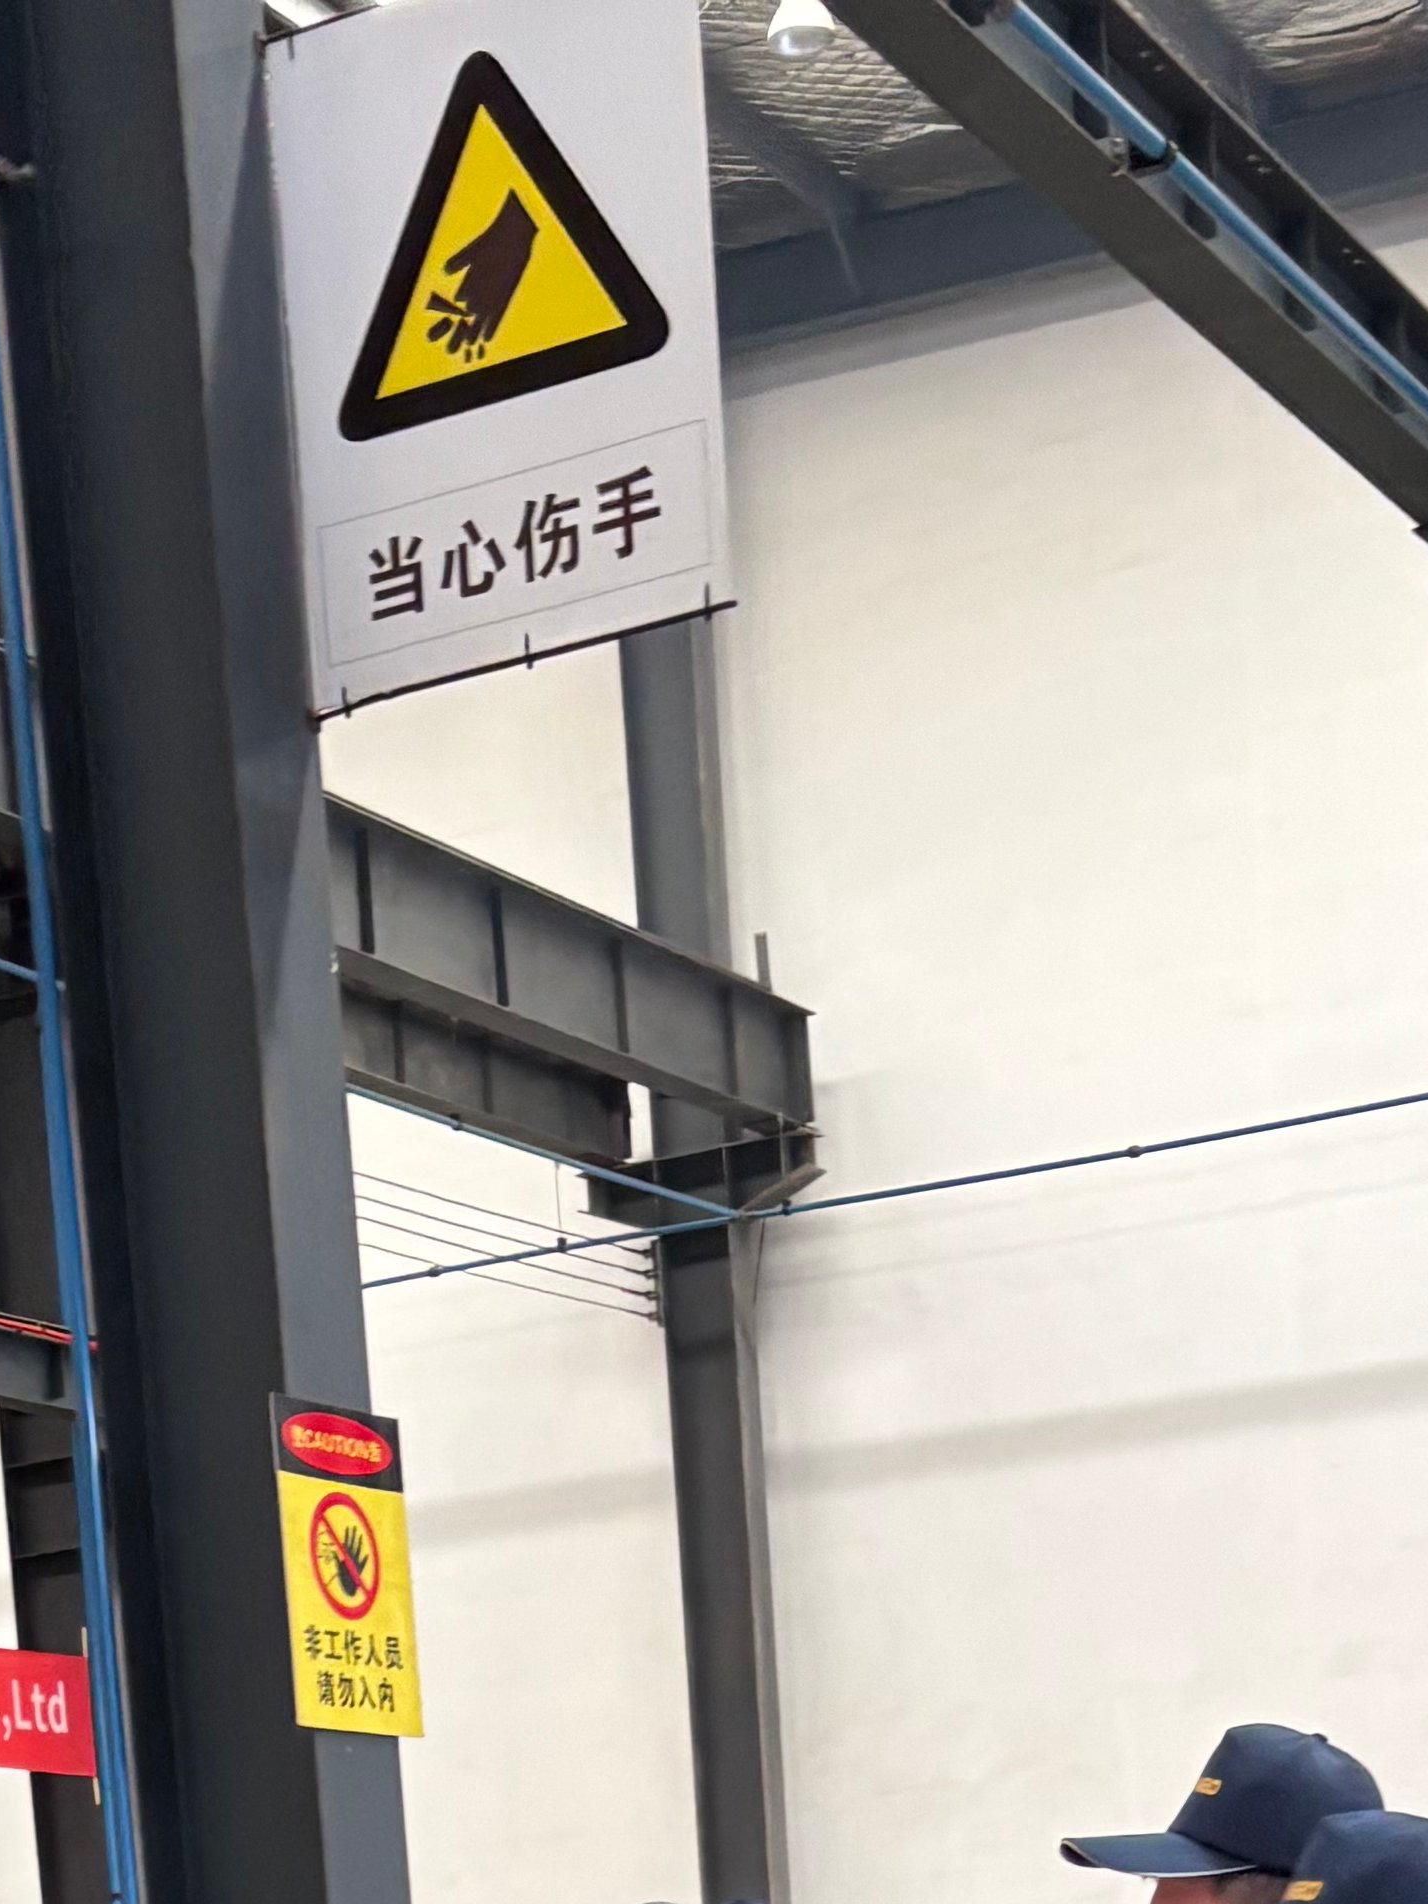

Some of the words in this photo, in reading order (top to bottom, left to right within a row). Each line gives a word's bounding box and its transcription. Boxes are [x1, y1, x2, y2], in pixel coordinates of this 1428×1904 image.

[367, 465, 662, 622] 当心伤手
[316, 1670, 395, 1712] 请勿入内
